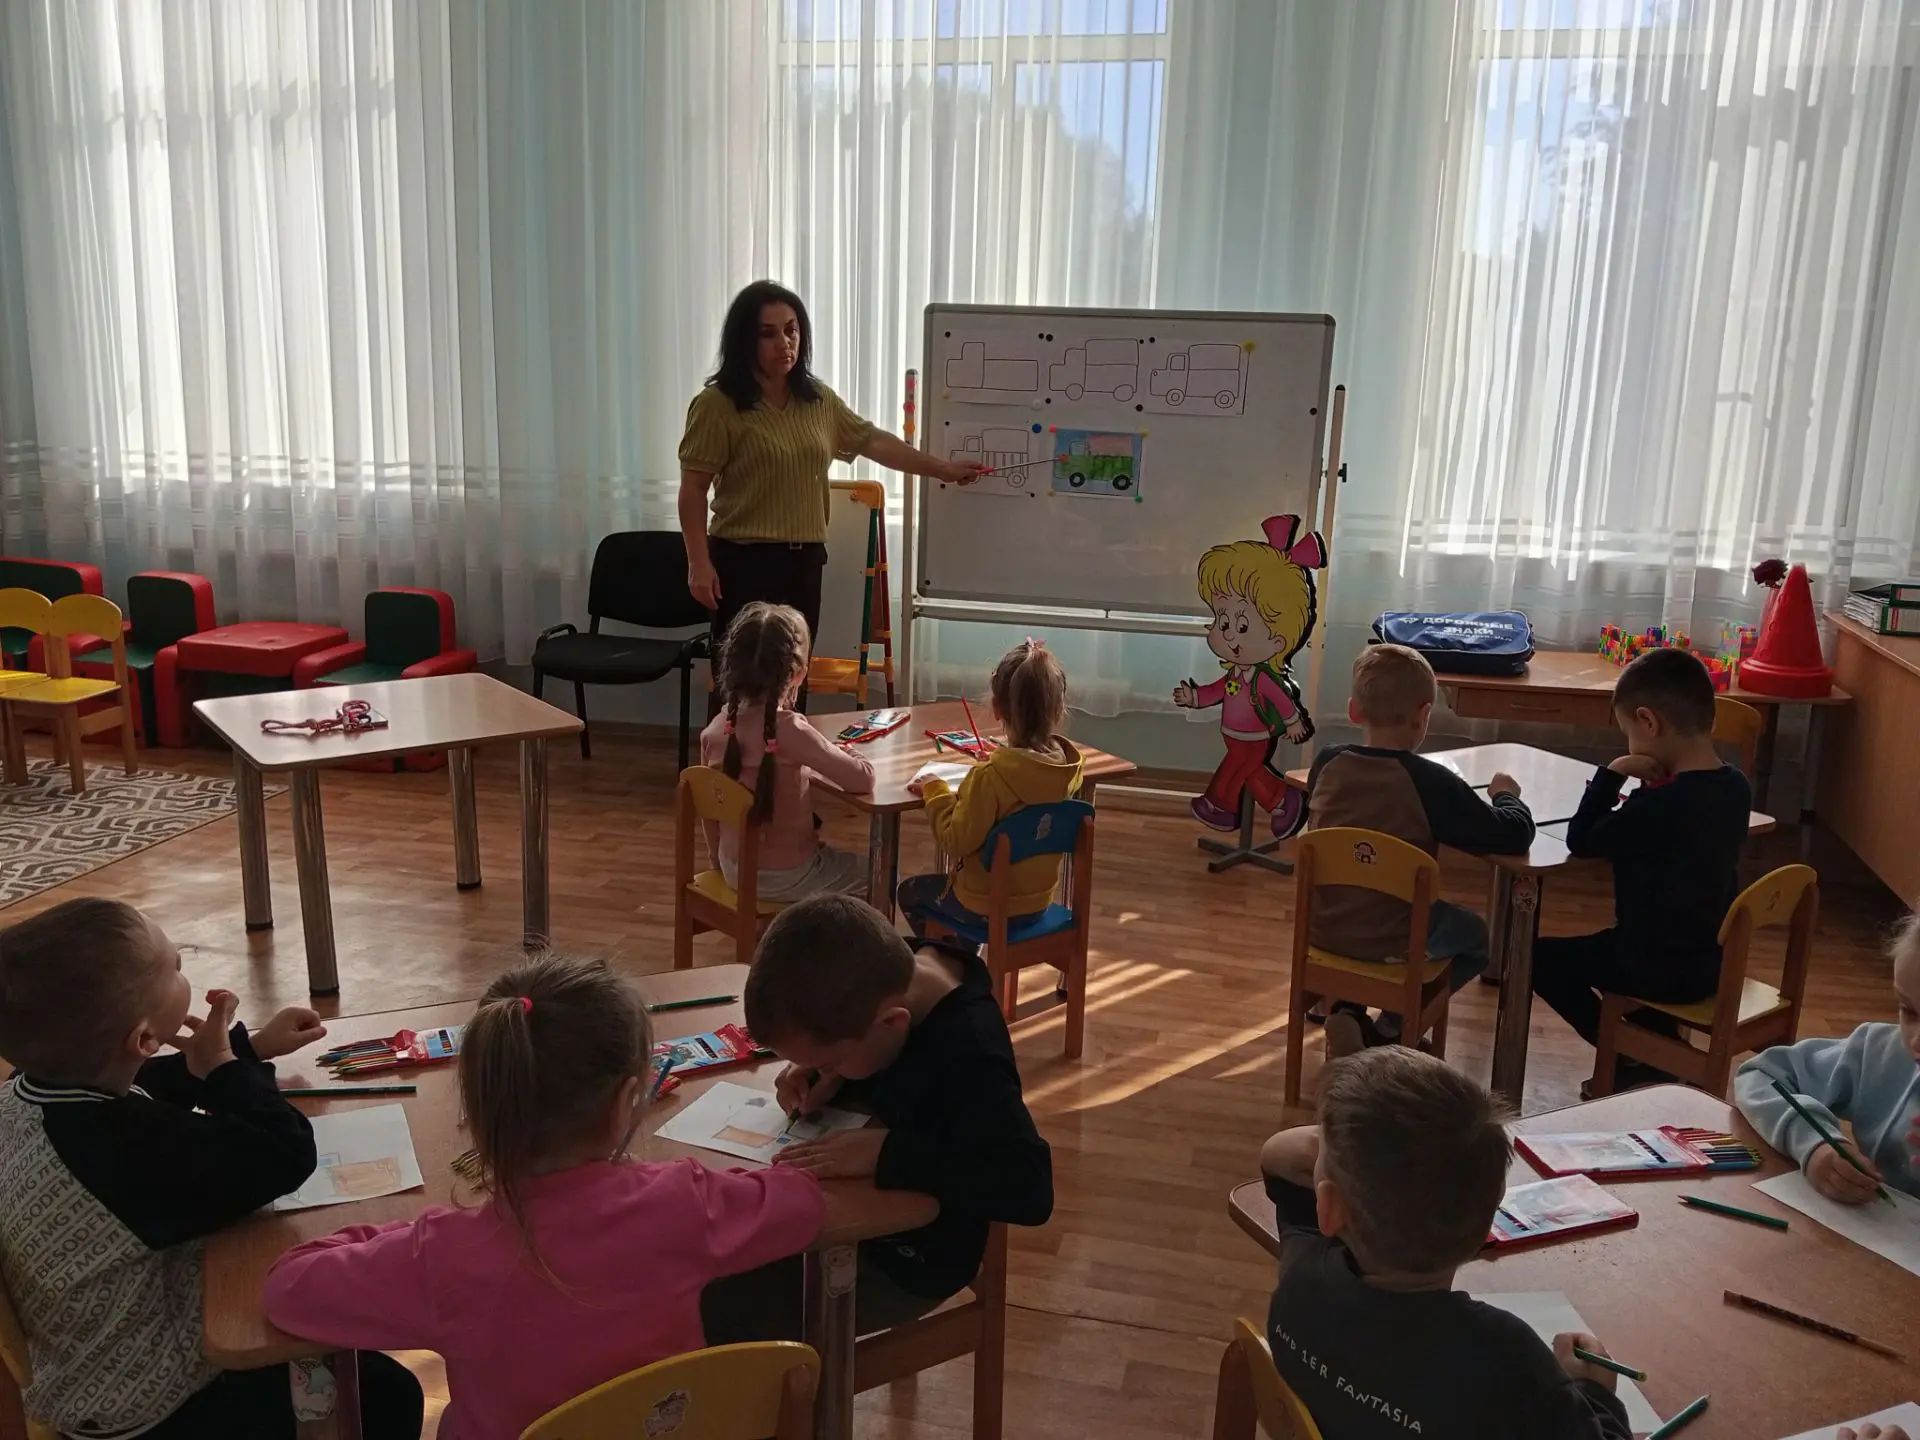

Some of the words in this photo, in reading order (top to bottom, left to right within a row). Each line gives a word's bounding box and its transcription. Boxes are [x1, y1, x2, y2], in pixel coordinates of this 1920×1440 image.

[1422, 617, 1513, 630] ДОРОЖНЫЕ
[1443, 626, 1494, 636] ЗНАКИ
[1336, 1376, 1423, 1435] FANTASIA
